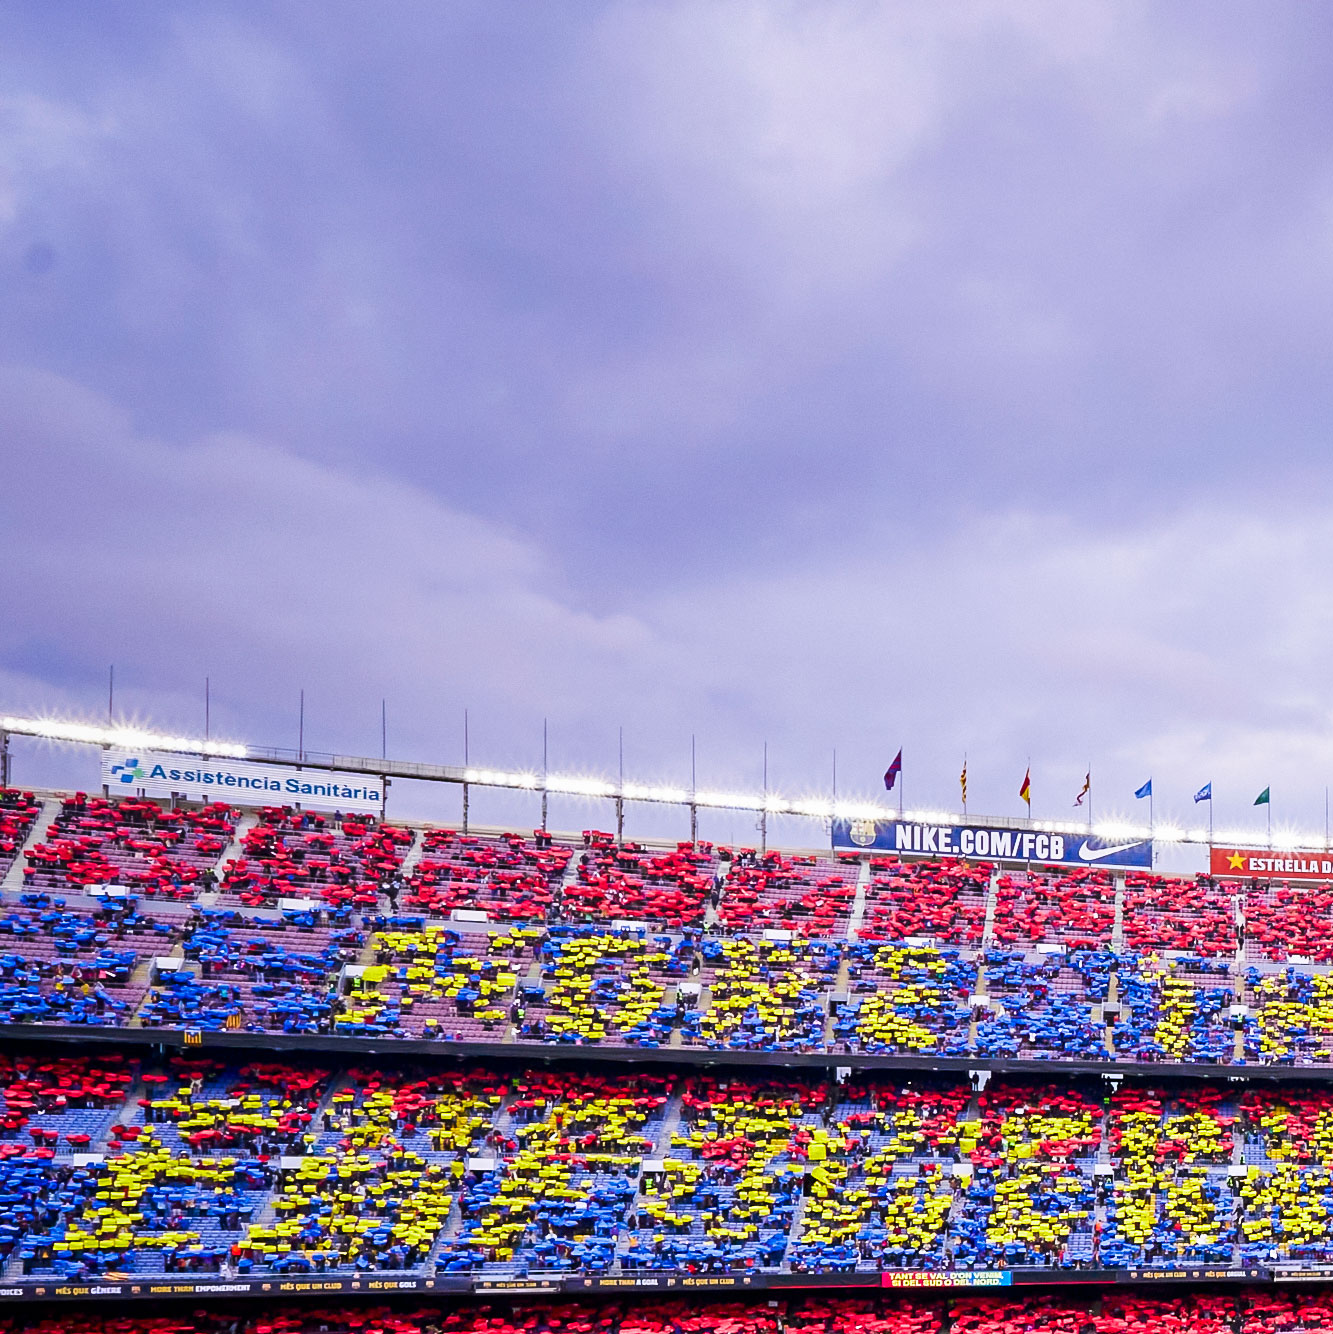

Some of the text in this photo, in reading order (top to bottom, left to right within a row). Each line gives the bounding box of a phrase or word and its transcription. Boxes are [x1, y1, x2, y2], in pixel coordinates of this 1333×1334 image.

[149, 763, 380, 801] Assistència Sanitària
[895, 824, 1065, 861] NIKE.COM/FCB
[1248, 856, 1319, 873] ESTRELLA
[296, 1283, 311, 1291] QUE
[323, 1282, 342, 1290] CLUB
[384, 1281, 398, 1289] QUE
[399, 1280, 417, 1288] GOLS
[618, 1278, 635, 1286] THAN
[0, 1288, 23, 1296] OICES
[73, 1287, 89, 1296] QUE
[150, 1286, 172, 1294] MORE
[174, 1285, 194, 1293] THAN
